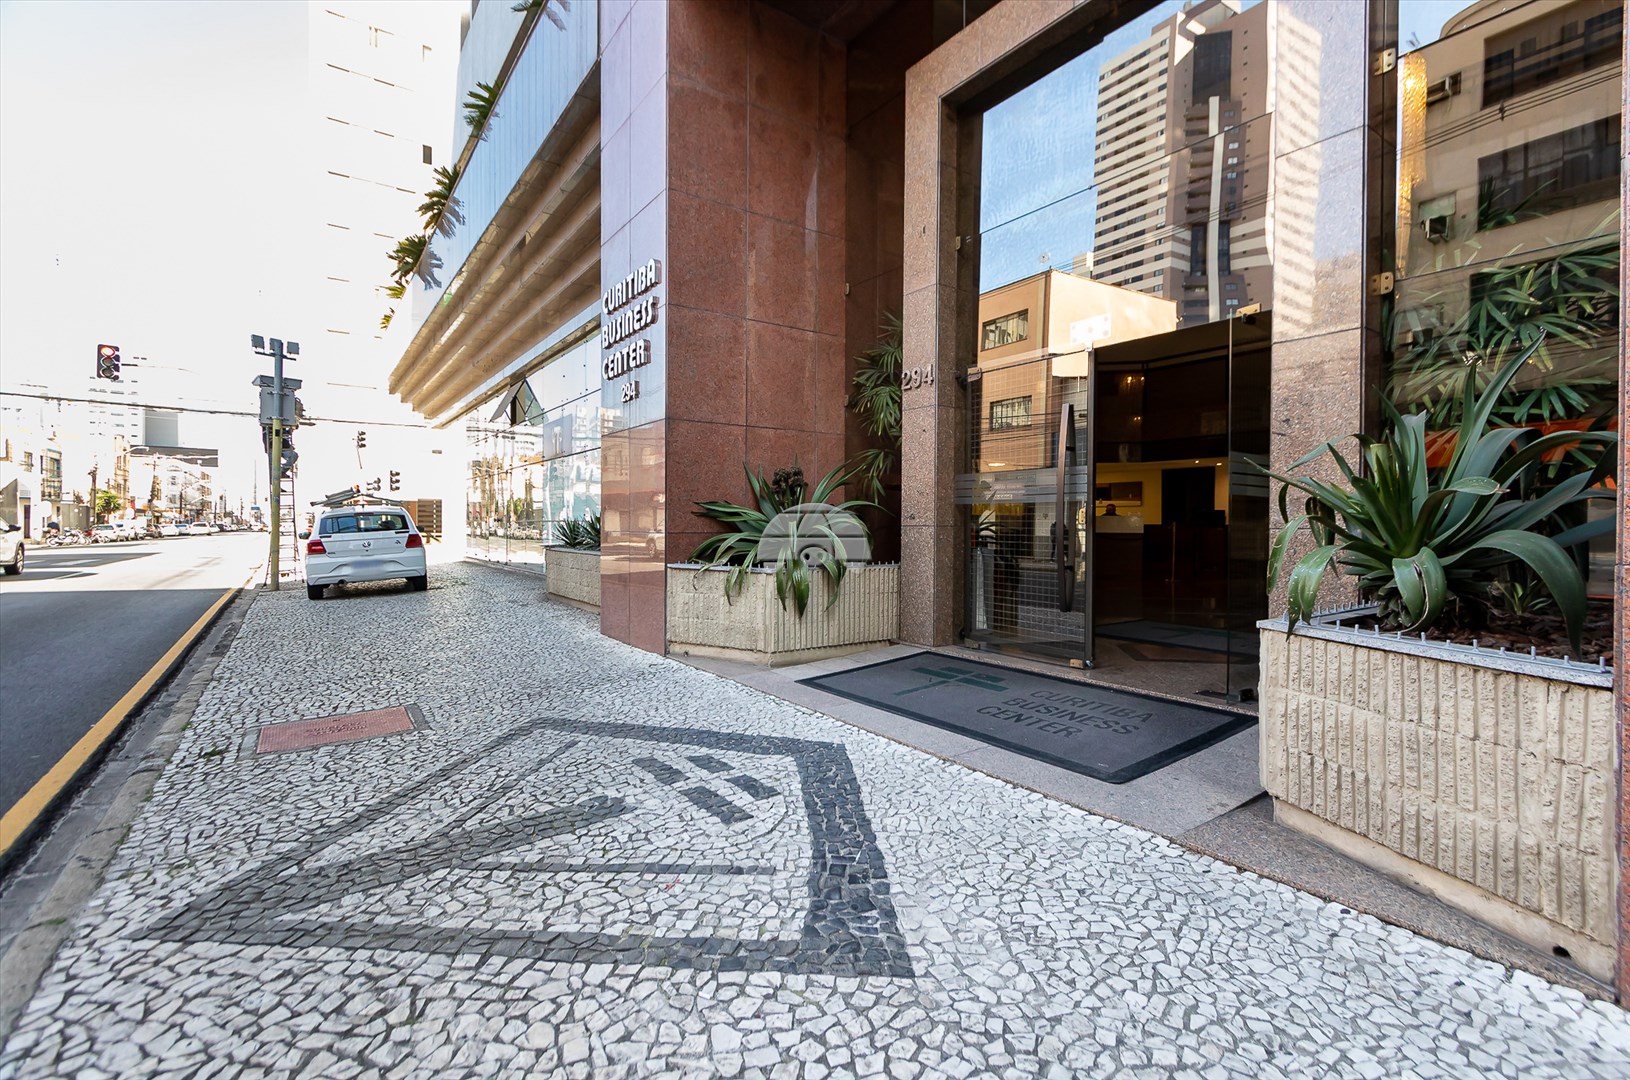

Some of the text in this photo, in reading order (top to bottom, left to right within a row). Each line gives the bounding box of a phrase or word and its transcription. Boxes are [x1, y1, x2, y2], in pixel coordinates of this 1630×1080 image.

[602, 258, 660, 314] CURITIBA
[602, 296, 658, 349] BUSINESS
[602, 338, 649, 380] CENTER
[620, 380, 638, 403] 294
[901, 364, 934, 391] 294
[976, 706, 1083, 738] CENTER
[1001, 697, 1140, 735] BUSINESS
[1030, 690, 1153, 723] CURITIBA
